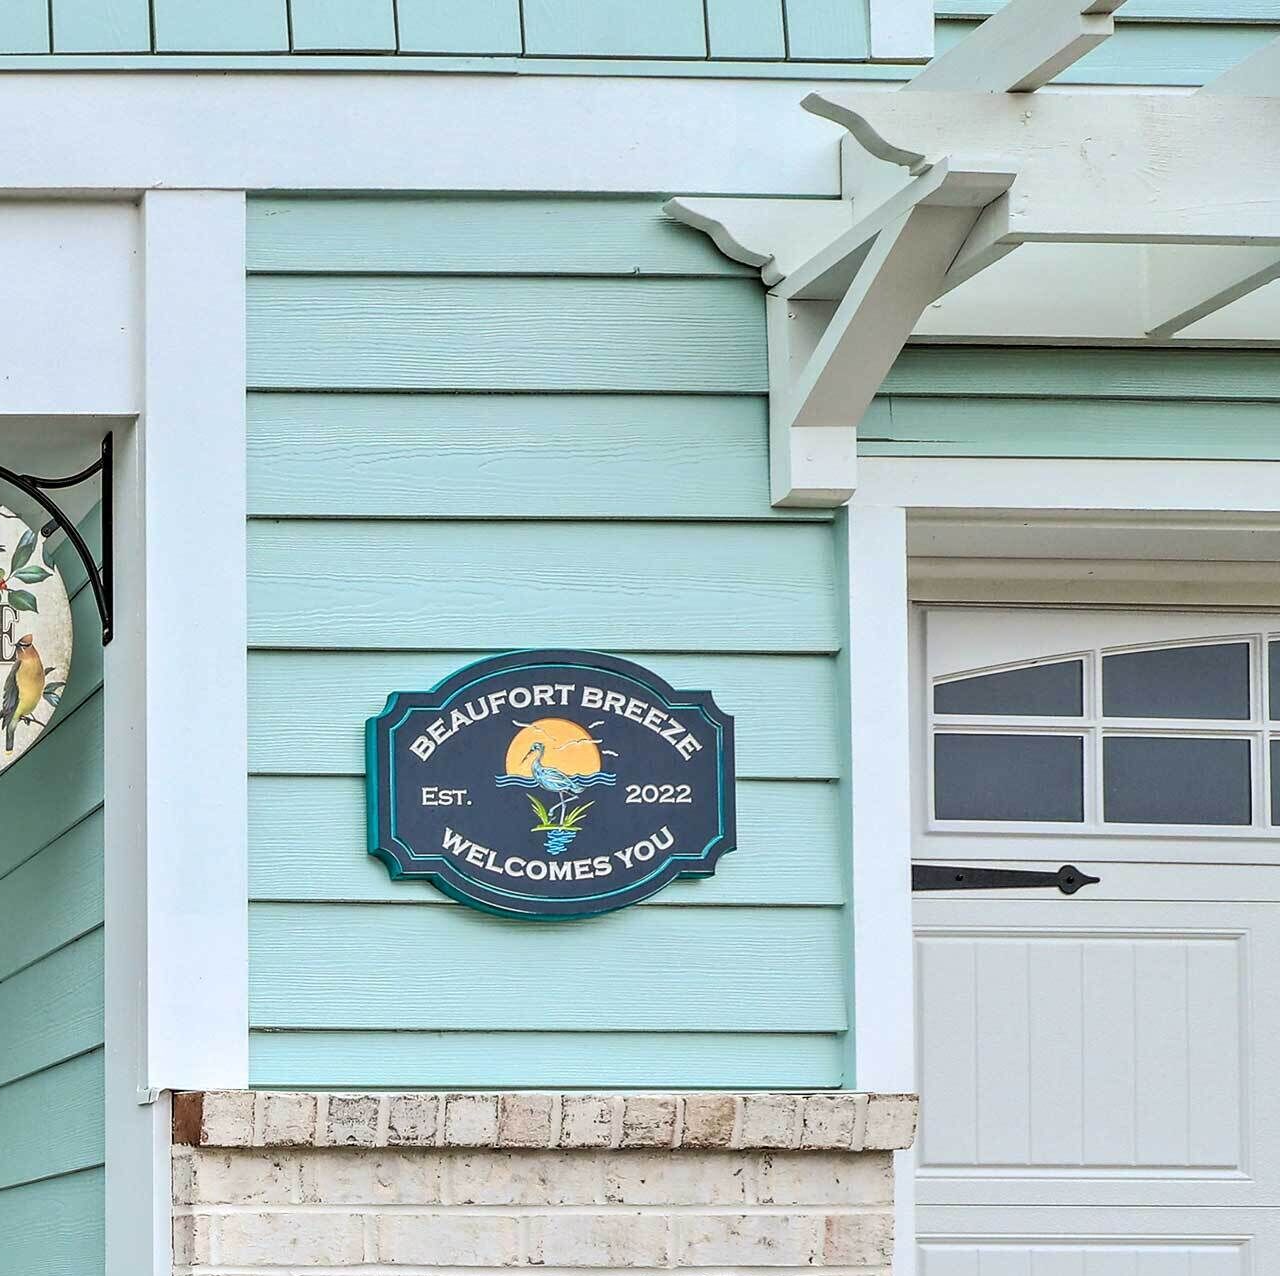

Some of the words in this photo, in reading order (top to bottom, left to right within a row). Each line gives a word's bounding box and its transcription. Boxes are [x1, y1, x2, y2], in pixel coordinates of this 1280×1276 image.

[408, 683, 576, 762] BEAUFORT
[581, 686, 703, 761] BREEZE
[625, 784, 693, 804] 2022
[441, 826, 610, 882] WELCOMES
[614, 826, 675, 870] YOU
